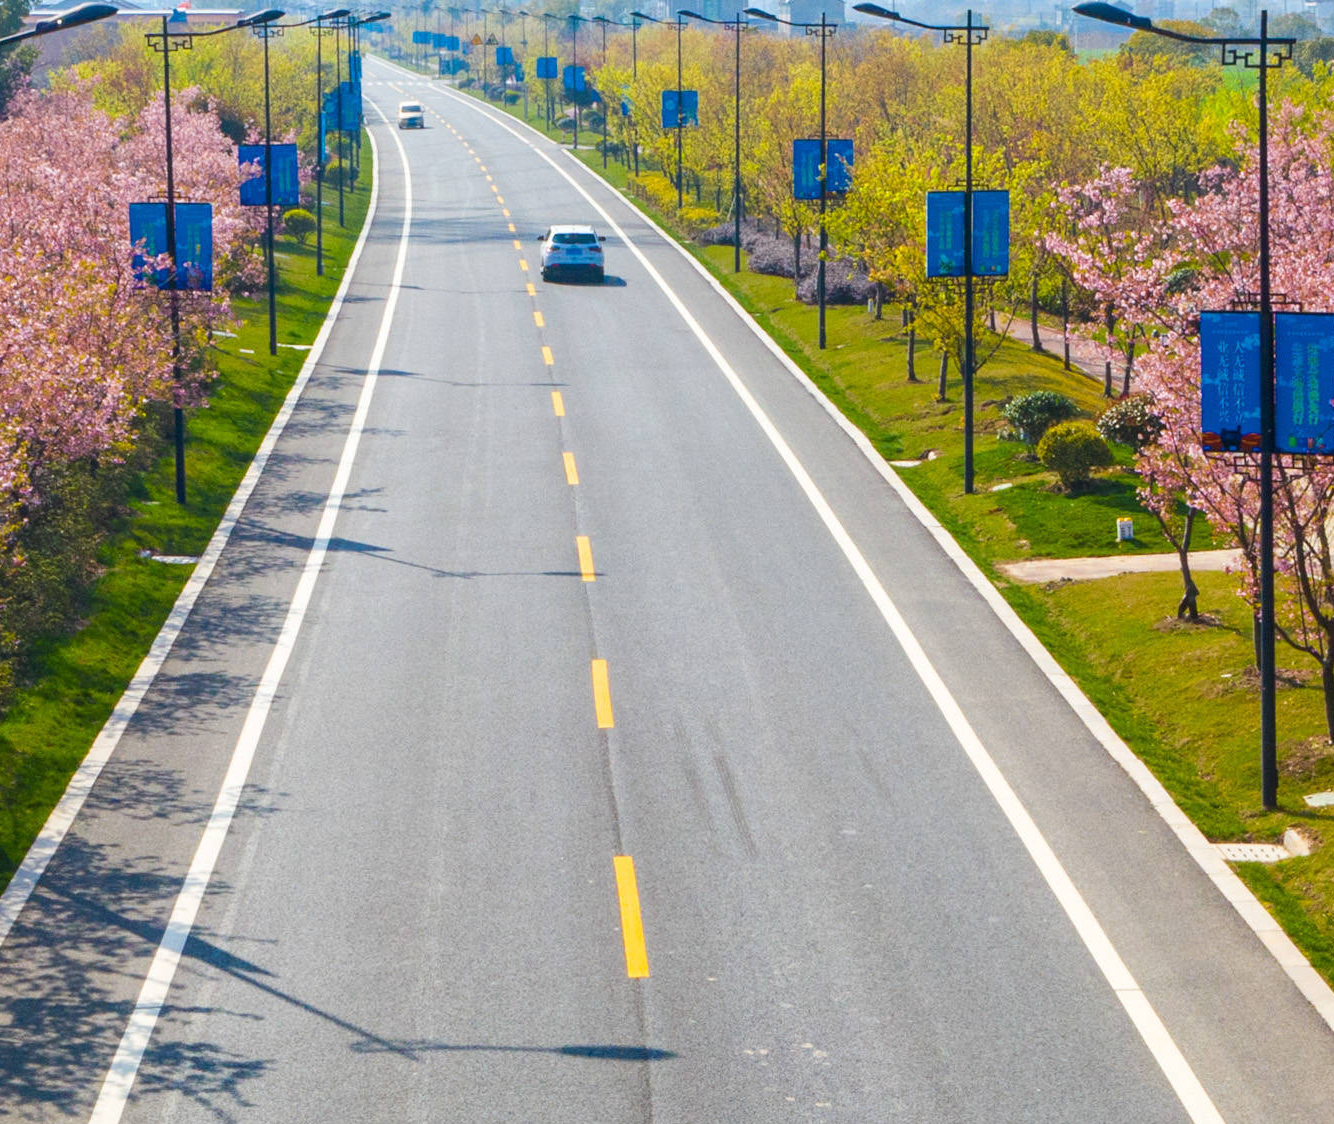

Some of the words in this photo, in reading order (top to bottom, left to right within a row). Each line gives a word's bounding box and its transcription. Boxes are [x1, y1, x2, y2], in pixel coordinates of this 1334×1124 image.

[1233, 339, 1244, 423] 人无诚信不立
